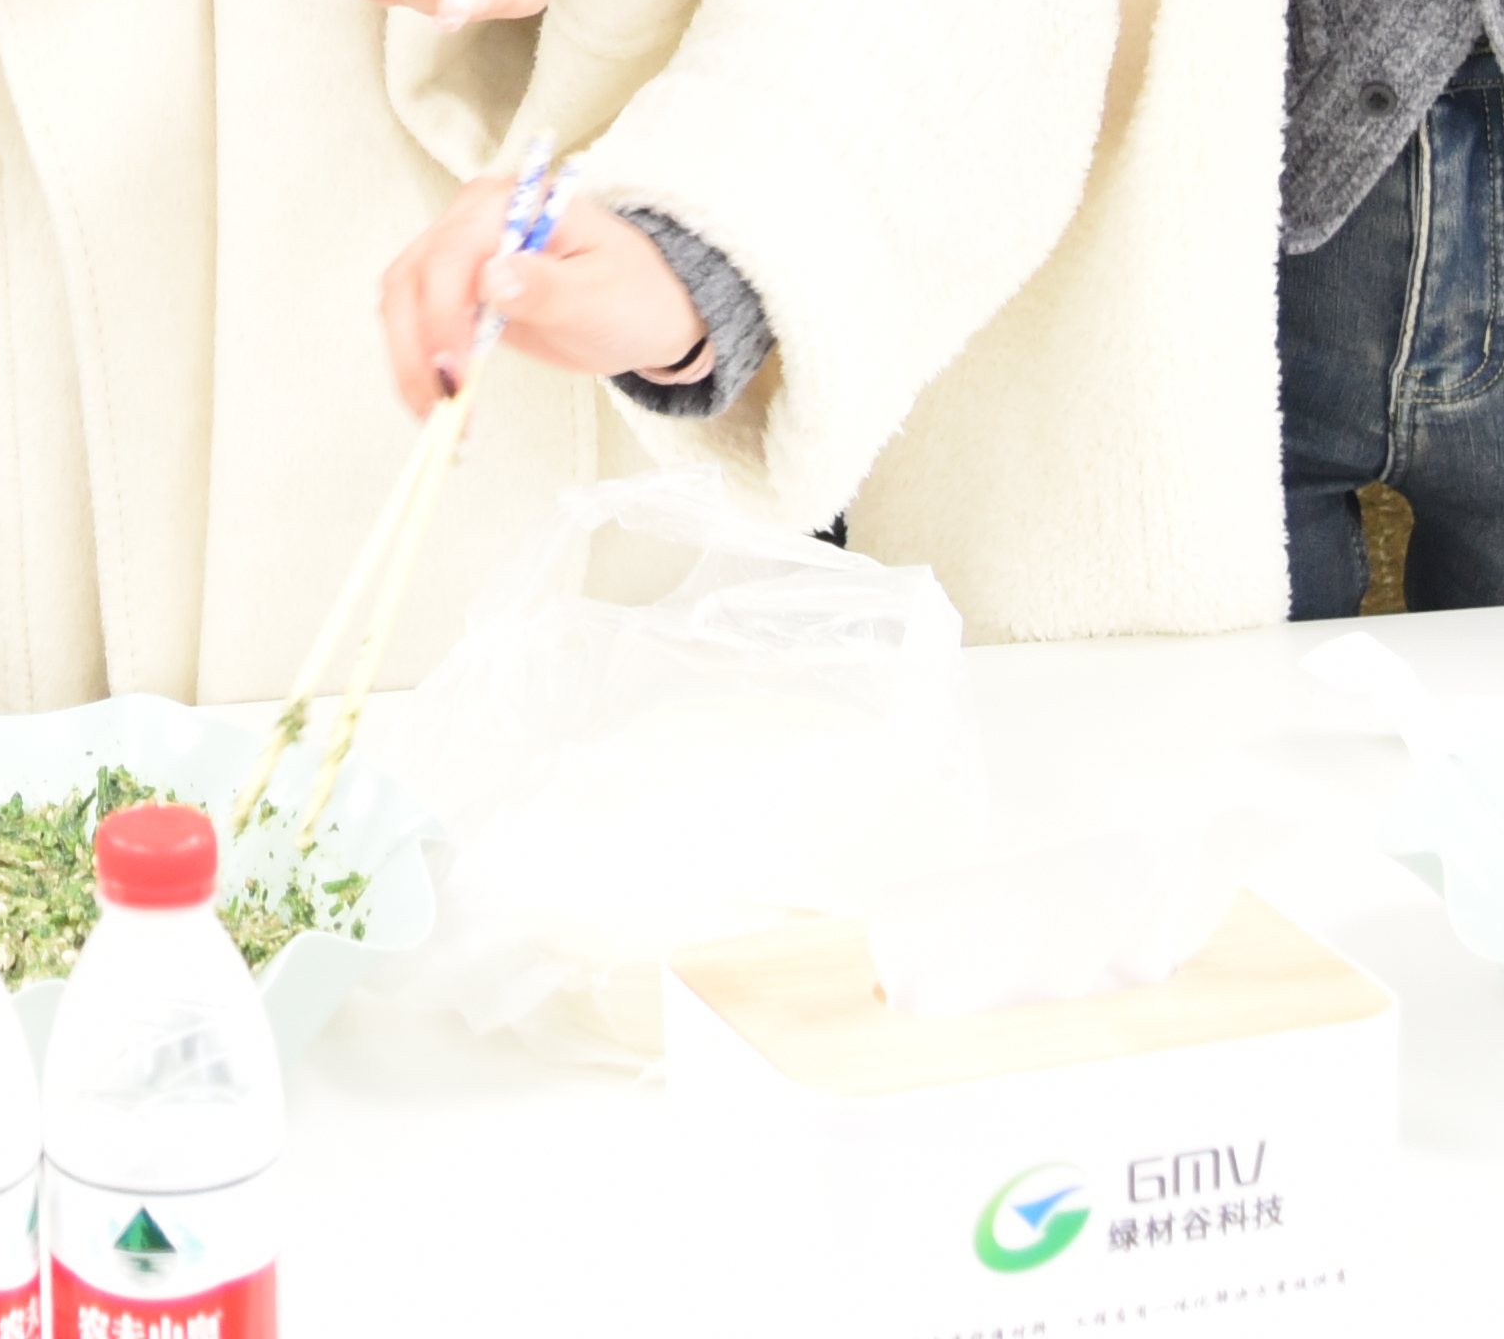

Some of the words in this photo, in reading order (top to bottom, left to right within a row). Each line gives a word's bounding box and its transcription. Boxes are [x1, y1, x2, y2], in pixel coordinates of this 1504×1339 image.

[1126, 1139, 1267, 1205] GMV
[1107, 1193, 1285, 1254] 绿材谷科技
